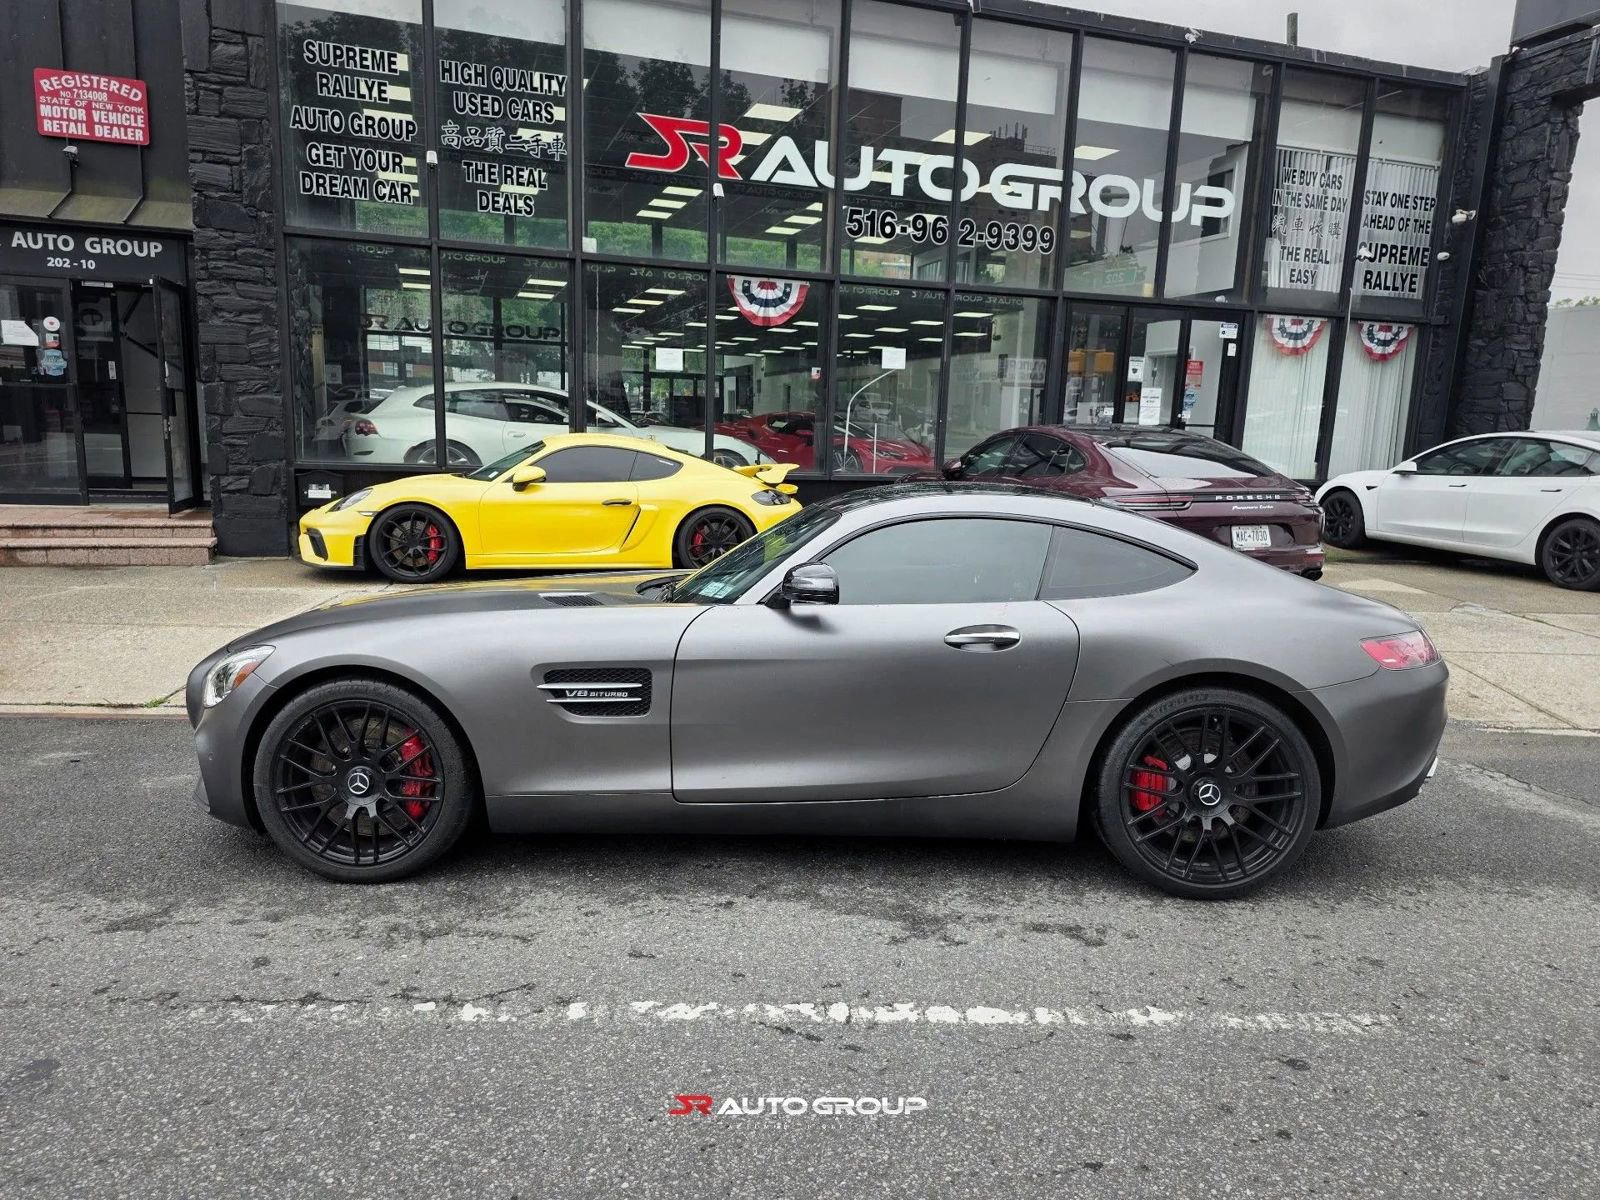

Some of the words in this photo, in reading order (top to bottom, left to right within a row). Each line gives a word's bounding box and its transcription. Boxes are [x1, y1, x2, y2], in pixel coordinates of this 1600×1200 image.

[303, 39, 399, 76] SUPREME
[40, 75, 142, 101] REGISTERED
[317, 72, 389, 104] RALLYE
[440, 60, 487, 88] HIGH
[491, 66, 568, 97] QUALITY
[40, 96, 71, 106] STATE
[75, 100, 88, 108] OF
[92, 102, 113, 111] NEW
[117, 105, 144, 114] YORK
[73, 89, 108, 101] 7134008
[453, 91, 503, 118] USED
[507, 98, 556, 125] CARS
[40, 105, 87, 121] MOTOR
[92, 110, 145, 127] VEHICLE
[290, 105, 345, 134] AUTO
[348, 112, 417, 143] GROUP
[43, 119, 90, 136] RETAIL
[94, 124, 144, 141] DEALER
[441, 120, 567, 162] 高品質二手車
[306, 142, 346, 169] GET
[349, 146, 405, 175] YOUR
[299, 171, 369, 201] DREAM
[373, 179, 414, 206] CAR
[462, 160, 499, 184] THE
[501, 165, 548, 191] REAL
[1282, 167, 1298, 186] WE
[1299, 170, 1318, 188] BUY
[1319, 172, 1343, 191] CARS
[477, 189, 535, 217] DEALS
[1272, 188, 1283, 207] IN
[1285, 191, 1302, 209] THE
[1304, 193, 1329, 212] SAME
[1330, 196, 1348, 214] DAY
[1364, 189, 1388, 208] STAY
[1390, 193, 1411, 211] ONE
[1412, 195, 1437, 213] STEP
[1362, 216, 1395, 234] AHEAD
[1397, 217, 1411, 232] OF
[1412, 218, 1432, 236] THE
[11, 231, 75, 252] AUTO
[84, 237, 163, 258] GROUP
[1280, 245, 1301, 263] THE
[1303, 248, 1330, 265] REAL
[1289, 268, 1317, 286] EASY
[1363, 270, 1419, 294] RALLYE
[565, 689, 588, 698] V8
[589, 690, 628, 698] BITURBO
